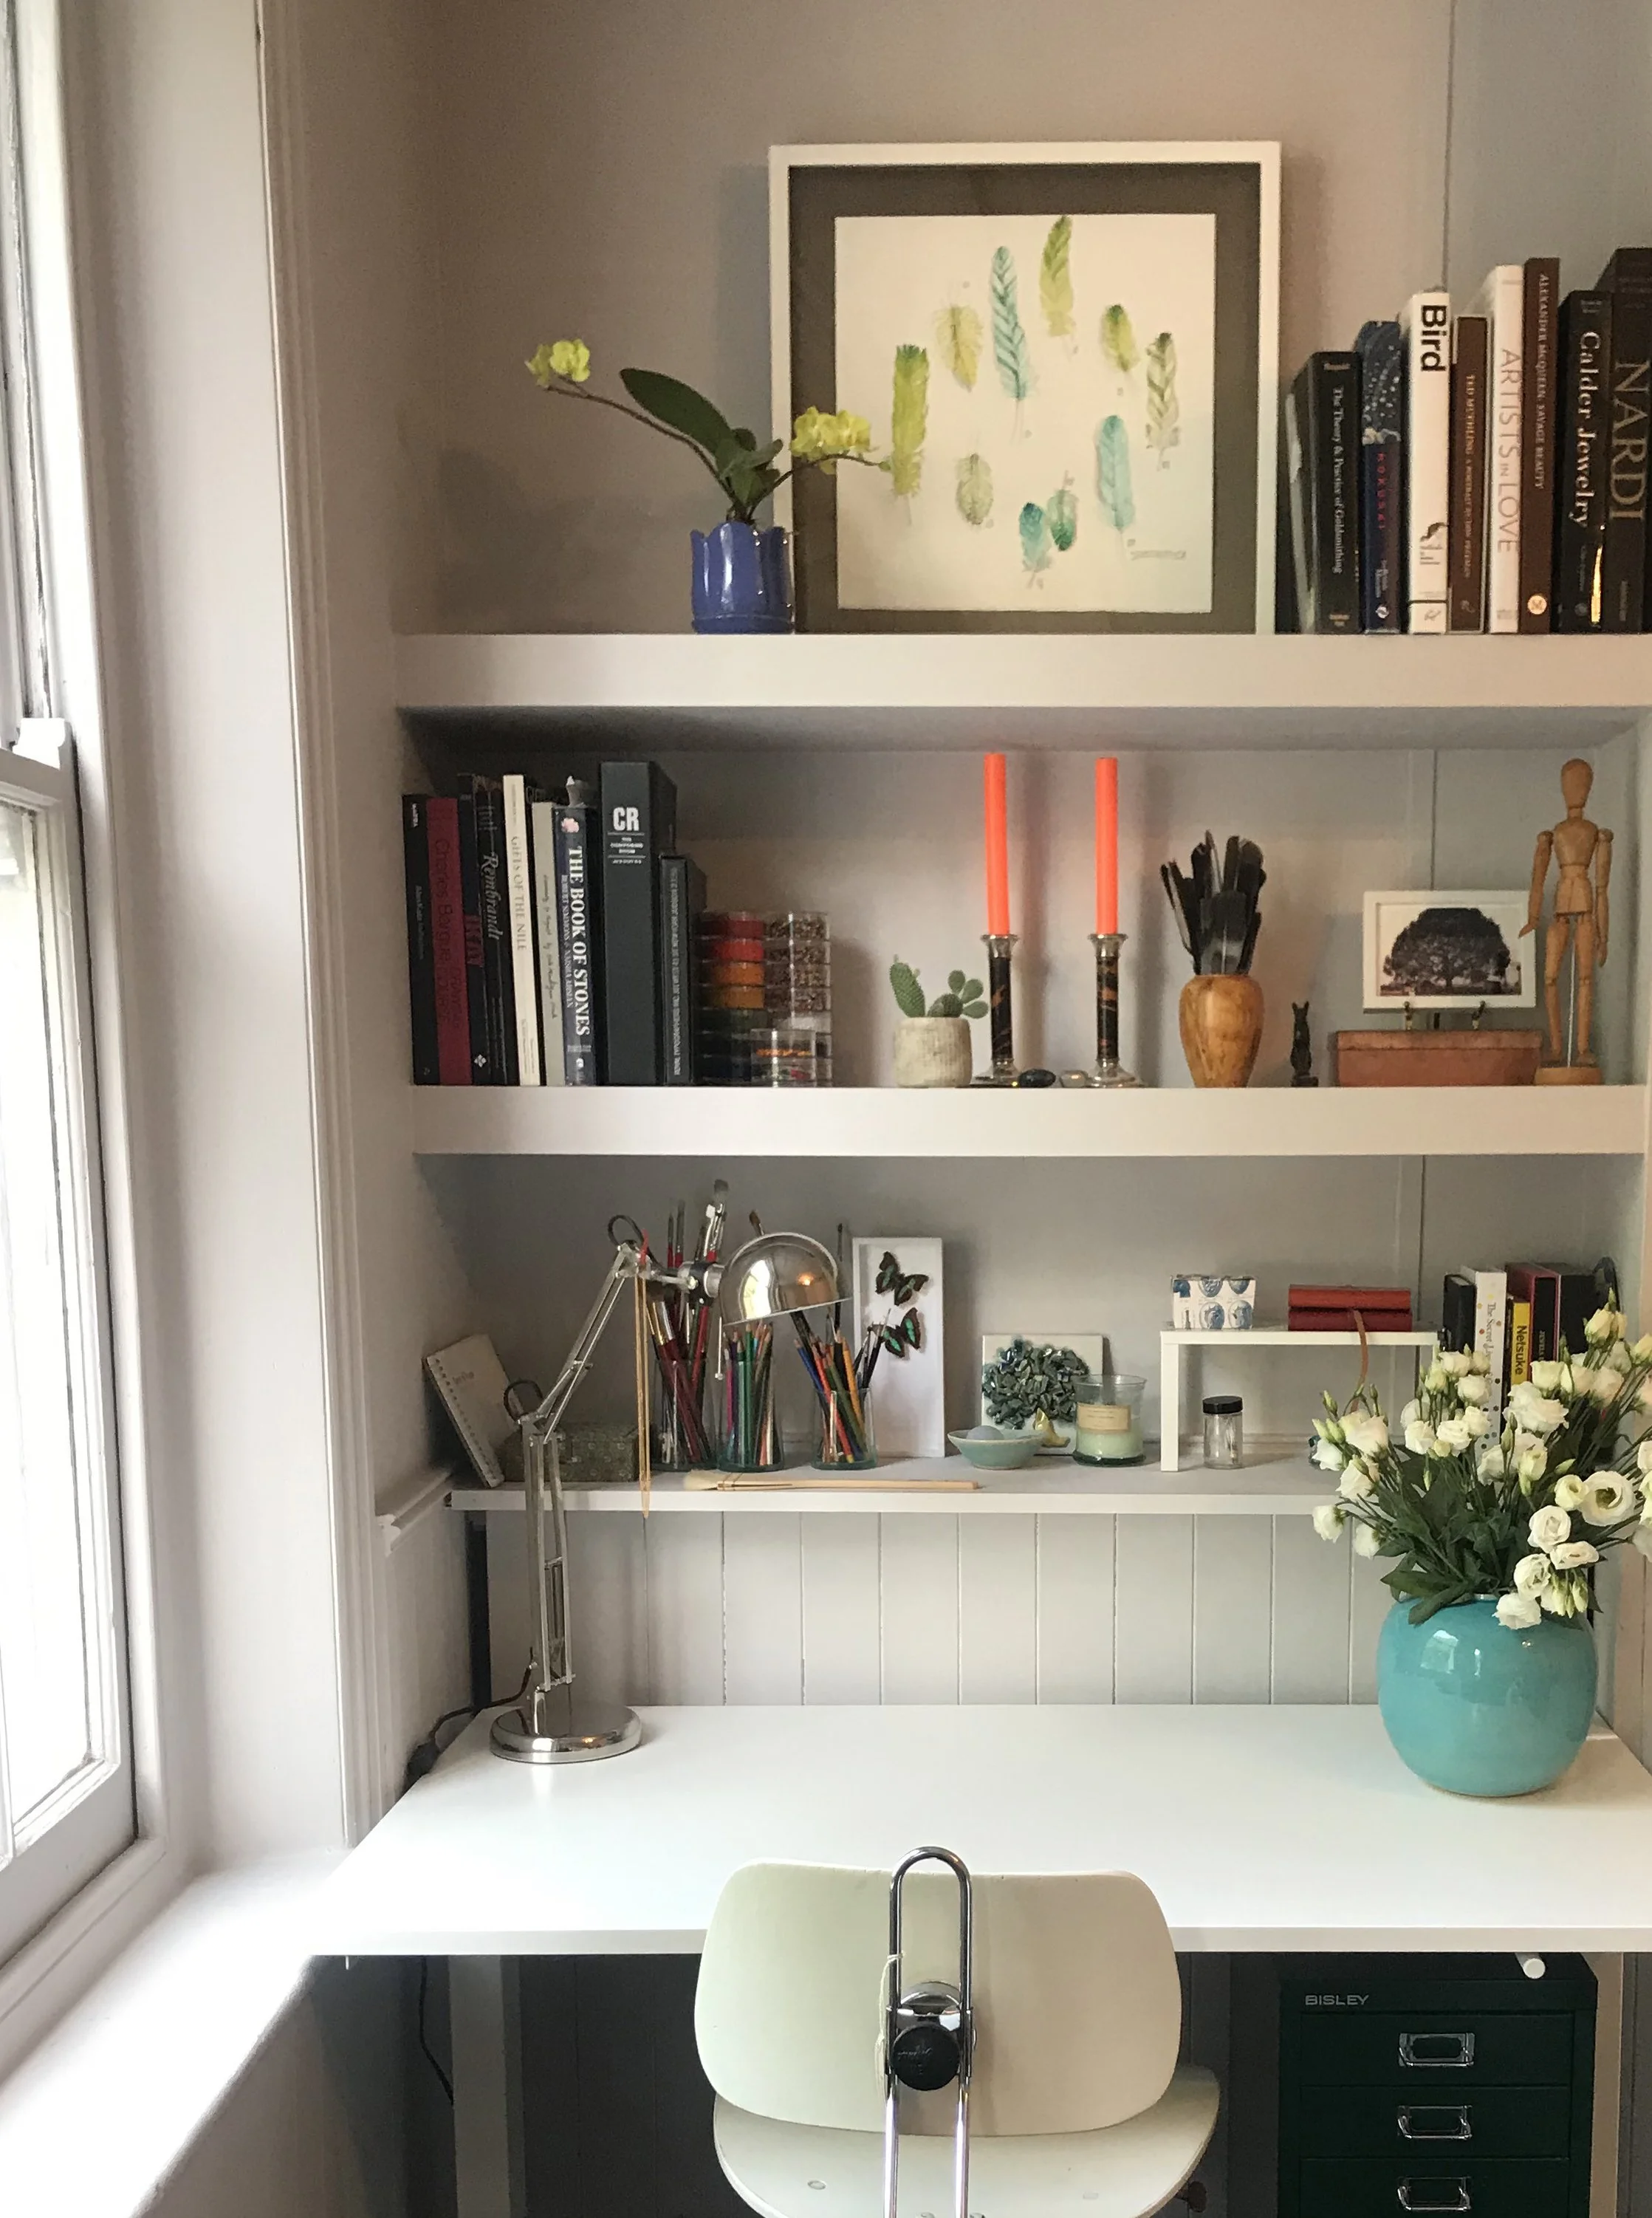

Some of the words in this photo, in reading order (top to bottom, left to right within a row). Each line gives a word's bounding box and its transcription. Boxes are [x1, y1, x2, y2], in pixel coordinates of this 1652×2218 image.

[1421, 305, 1447, 372] Bird
[1578, 332, 1602, 419] Calder
[1332, 387, 1345, 407] The
[1498, 348, 1522, 459] ARTISTS
[1331, 408, 1345, 442] Theory
[1609, 359, 1651, 521] NARDI
[1500, 462, 1511, 477] IN
[1569, 428, 1597, 529] Jewelry
[1497, 482, 1520, 553] LOVE
[613, 807, 640, 831] CR
[510, 836, 521, 871] GIFTS
[567, 845, 583, 884] THE
[481, 852, 504, 940] Rembrandt
[513, 874, 524, 890] OF
[514, 896, 525, 919] THE
[569, 888, 586, 938] BOOK
[515, 923, 527, 951] NILE
[572, 941, 588, 965] OF
[573, 968, 591, 1036] STONES
[1487, 1301, 1497, 1317] The
[1484, 1318, 1495, 1343] Secret
[1515, 1325, 1528, 1376] Netsuke
[1305, 1994, 1370, 2005] BISLEY
